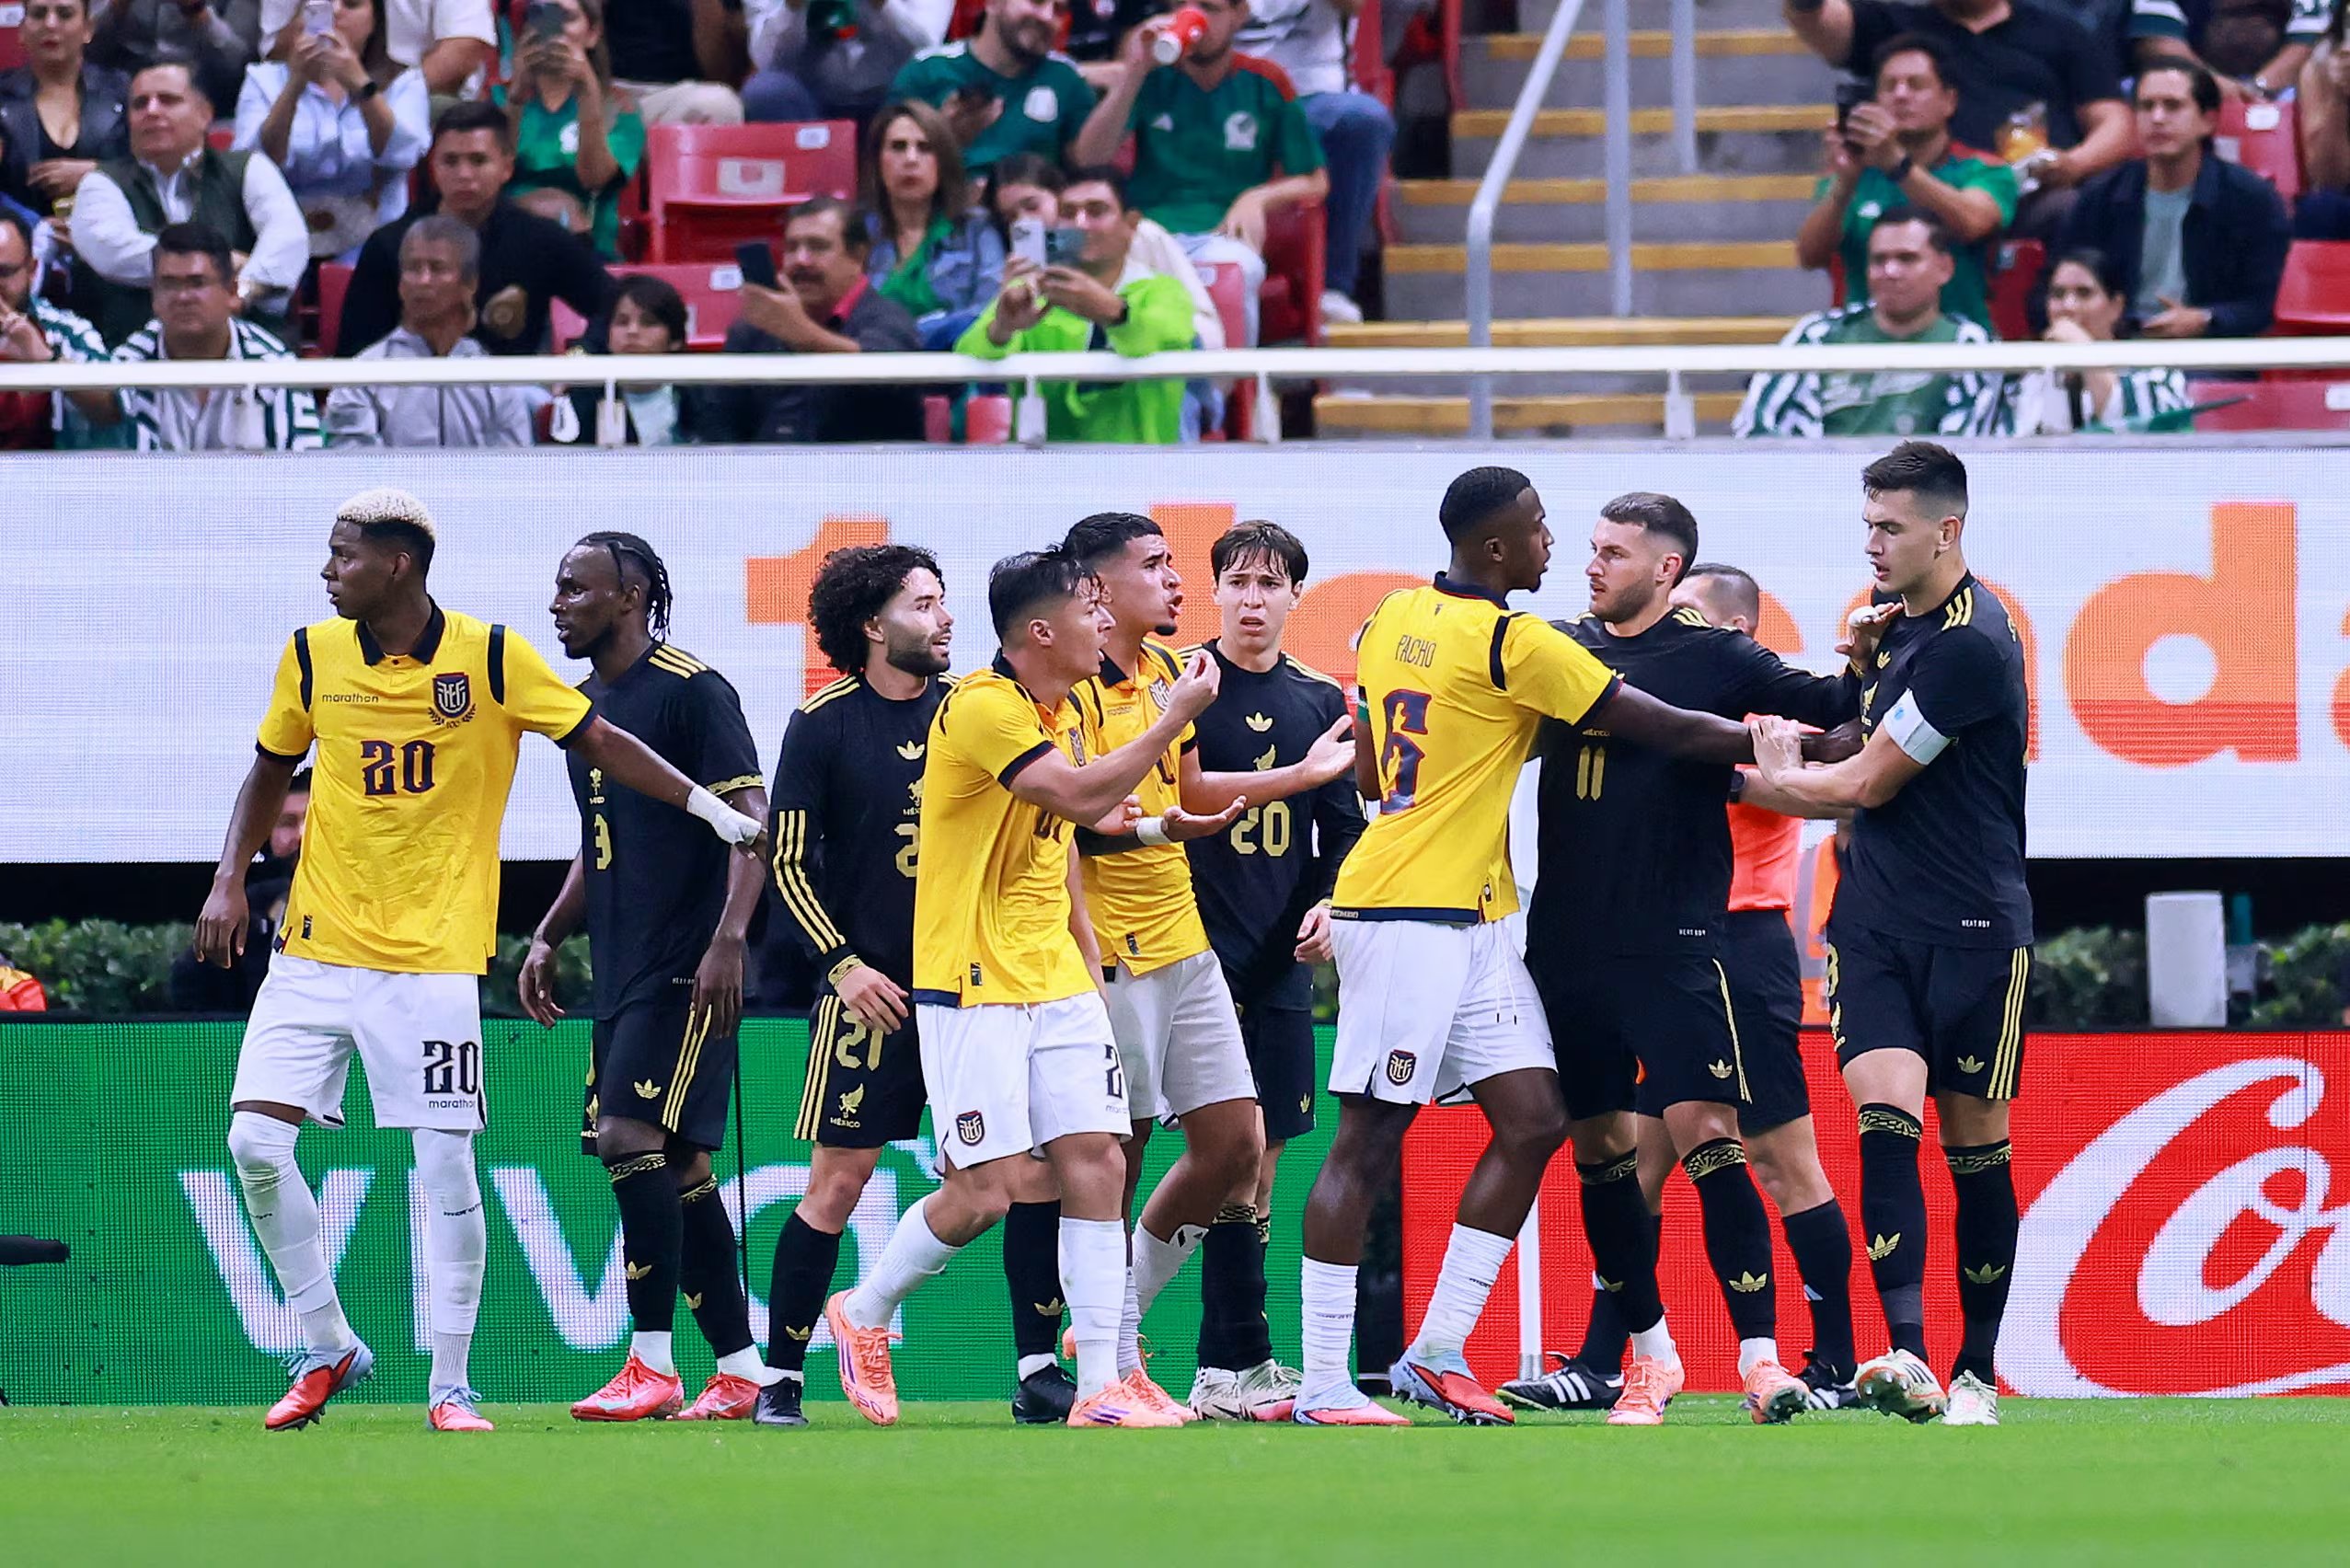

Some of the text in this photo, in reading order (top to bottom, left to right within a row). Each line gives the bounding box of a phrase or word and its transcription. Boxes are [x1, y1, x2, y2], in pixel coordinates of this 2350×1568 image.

[1395, 634, 1437, 668] PACHO
[322, 694, 379, 703] marathon
[361, 740, 435, 796] 20
[1380, 688, 1433, 816] 6
[1576, 745, 1607, 801] 11
[1230, 801, 1291, 858] 20
[421, 1041, 478, 1094] 20
[835, 1009, 883, 1071] 21
[428, 1099, 477, 1109] maratho
